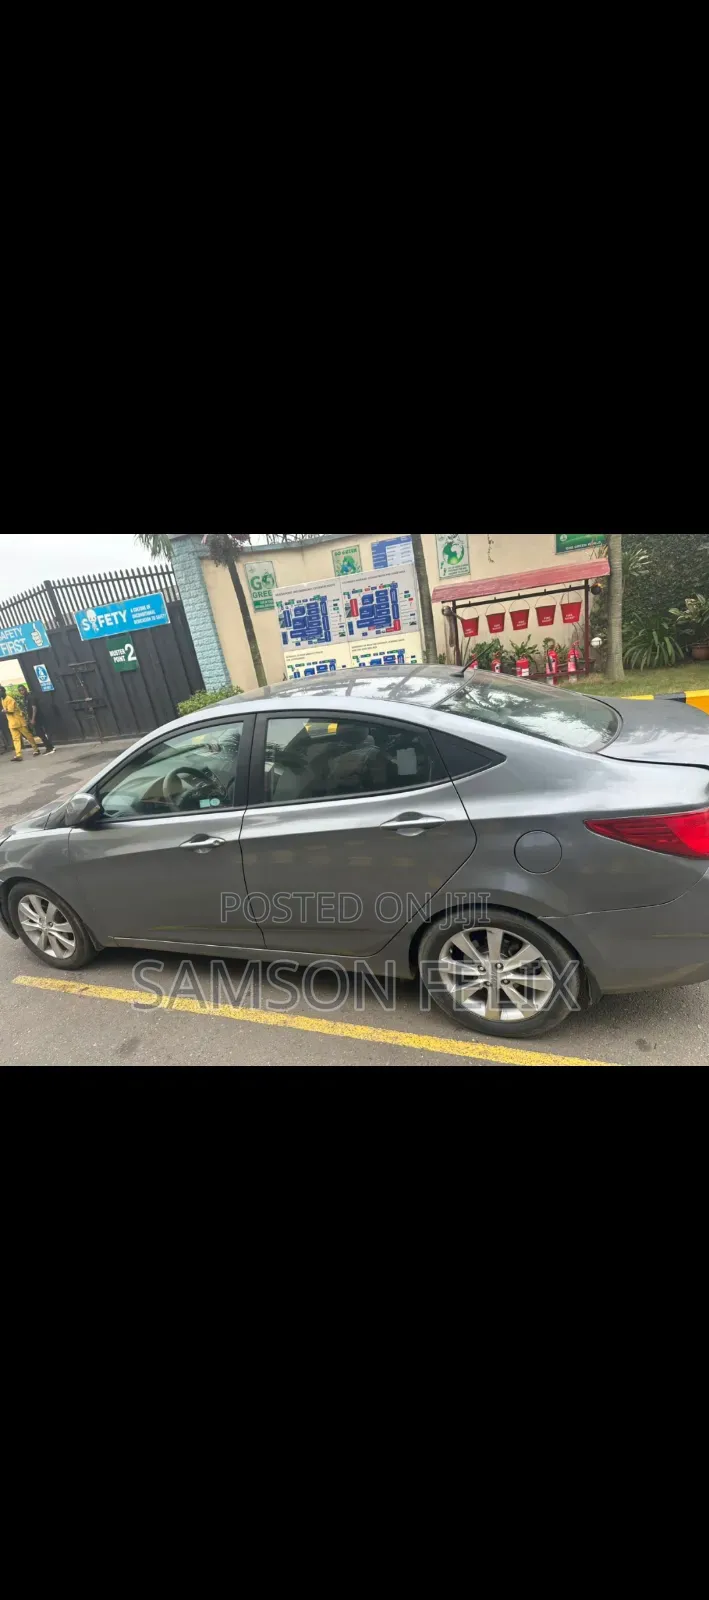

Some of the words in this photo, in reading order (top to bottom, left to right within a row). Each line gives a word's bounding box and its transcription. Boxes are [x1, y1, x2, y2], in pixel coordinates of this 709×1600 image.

[252, 589, 273, 599] GREE
[0, 626, 23, 641] AFETY
[0, 637, 26, 656] FIRST
[124, 643, 137, 661] 2
